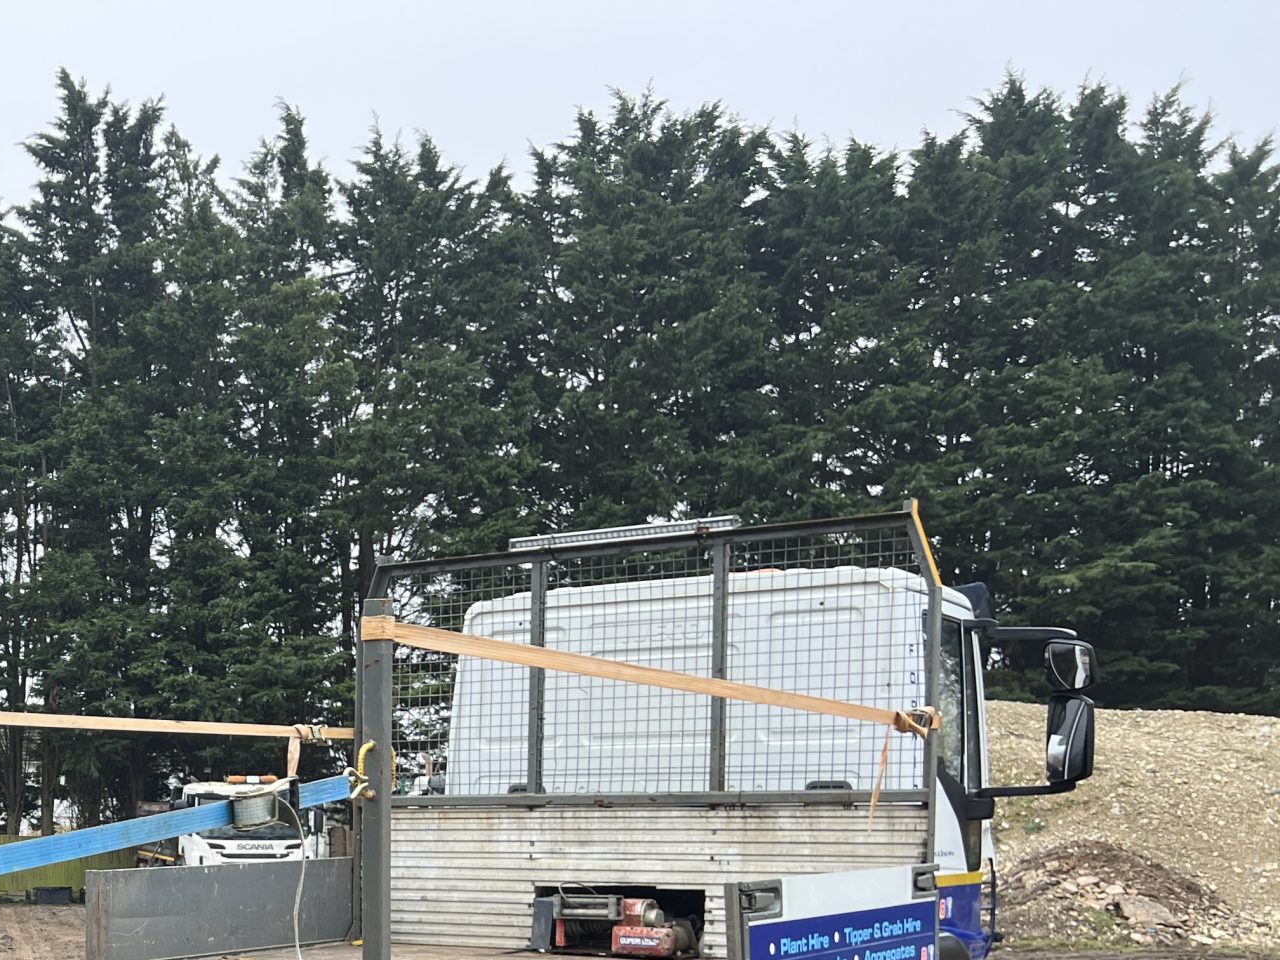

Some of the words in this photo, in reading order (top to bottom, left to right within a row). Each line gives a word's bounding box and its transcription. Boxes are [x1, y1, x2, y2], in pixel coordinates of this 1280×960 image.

[236, 843, 274, 851] SCANIA
[844, 926, 873, 947] Tipper
[873, 922, 882, 939] &
[882, 919, 903, 938] Grab
[903, 917, 921, 934] Hire
[780, 936, 808, 956] Plant
[808, 933, 830, 951] Hire
